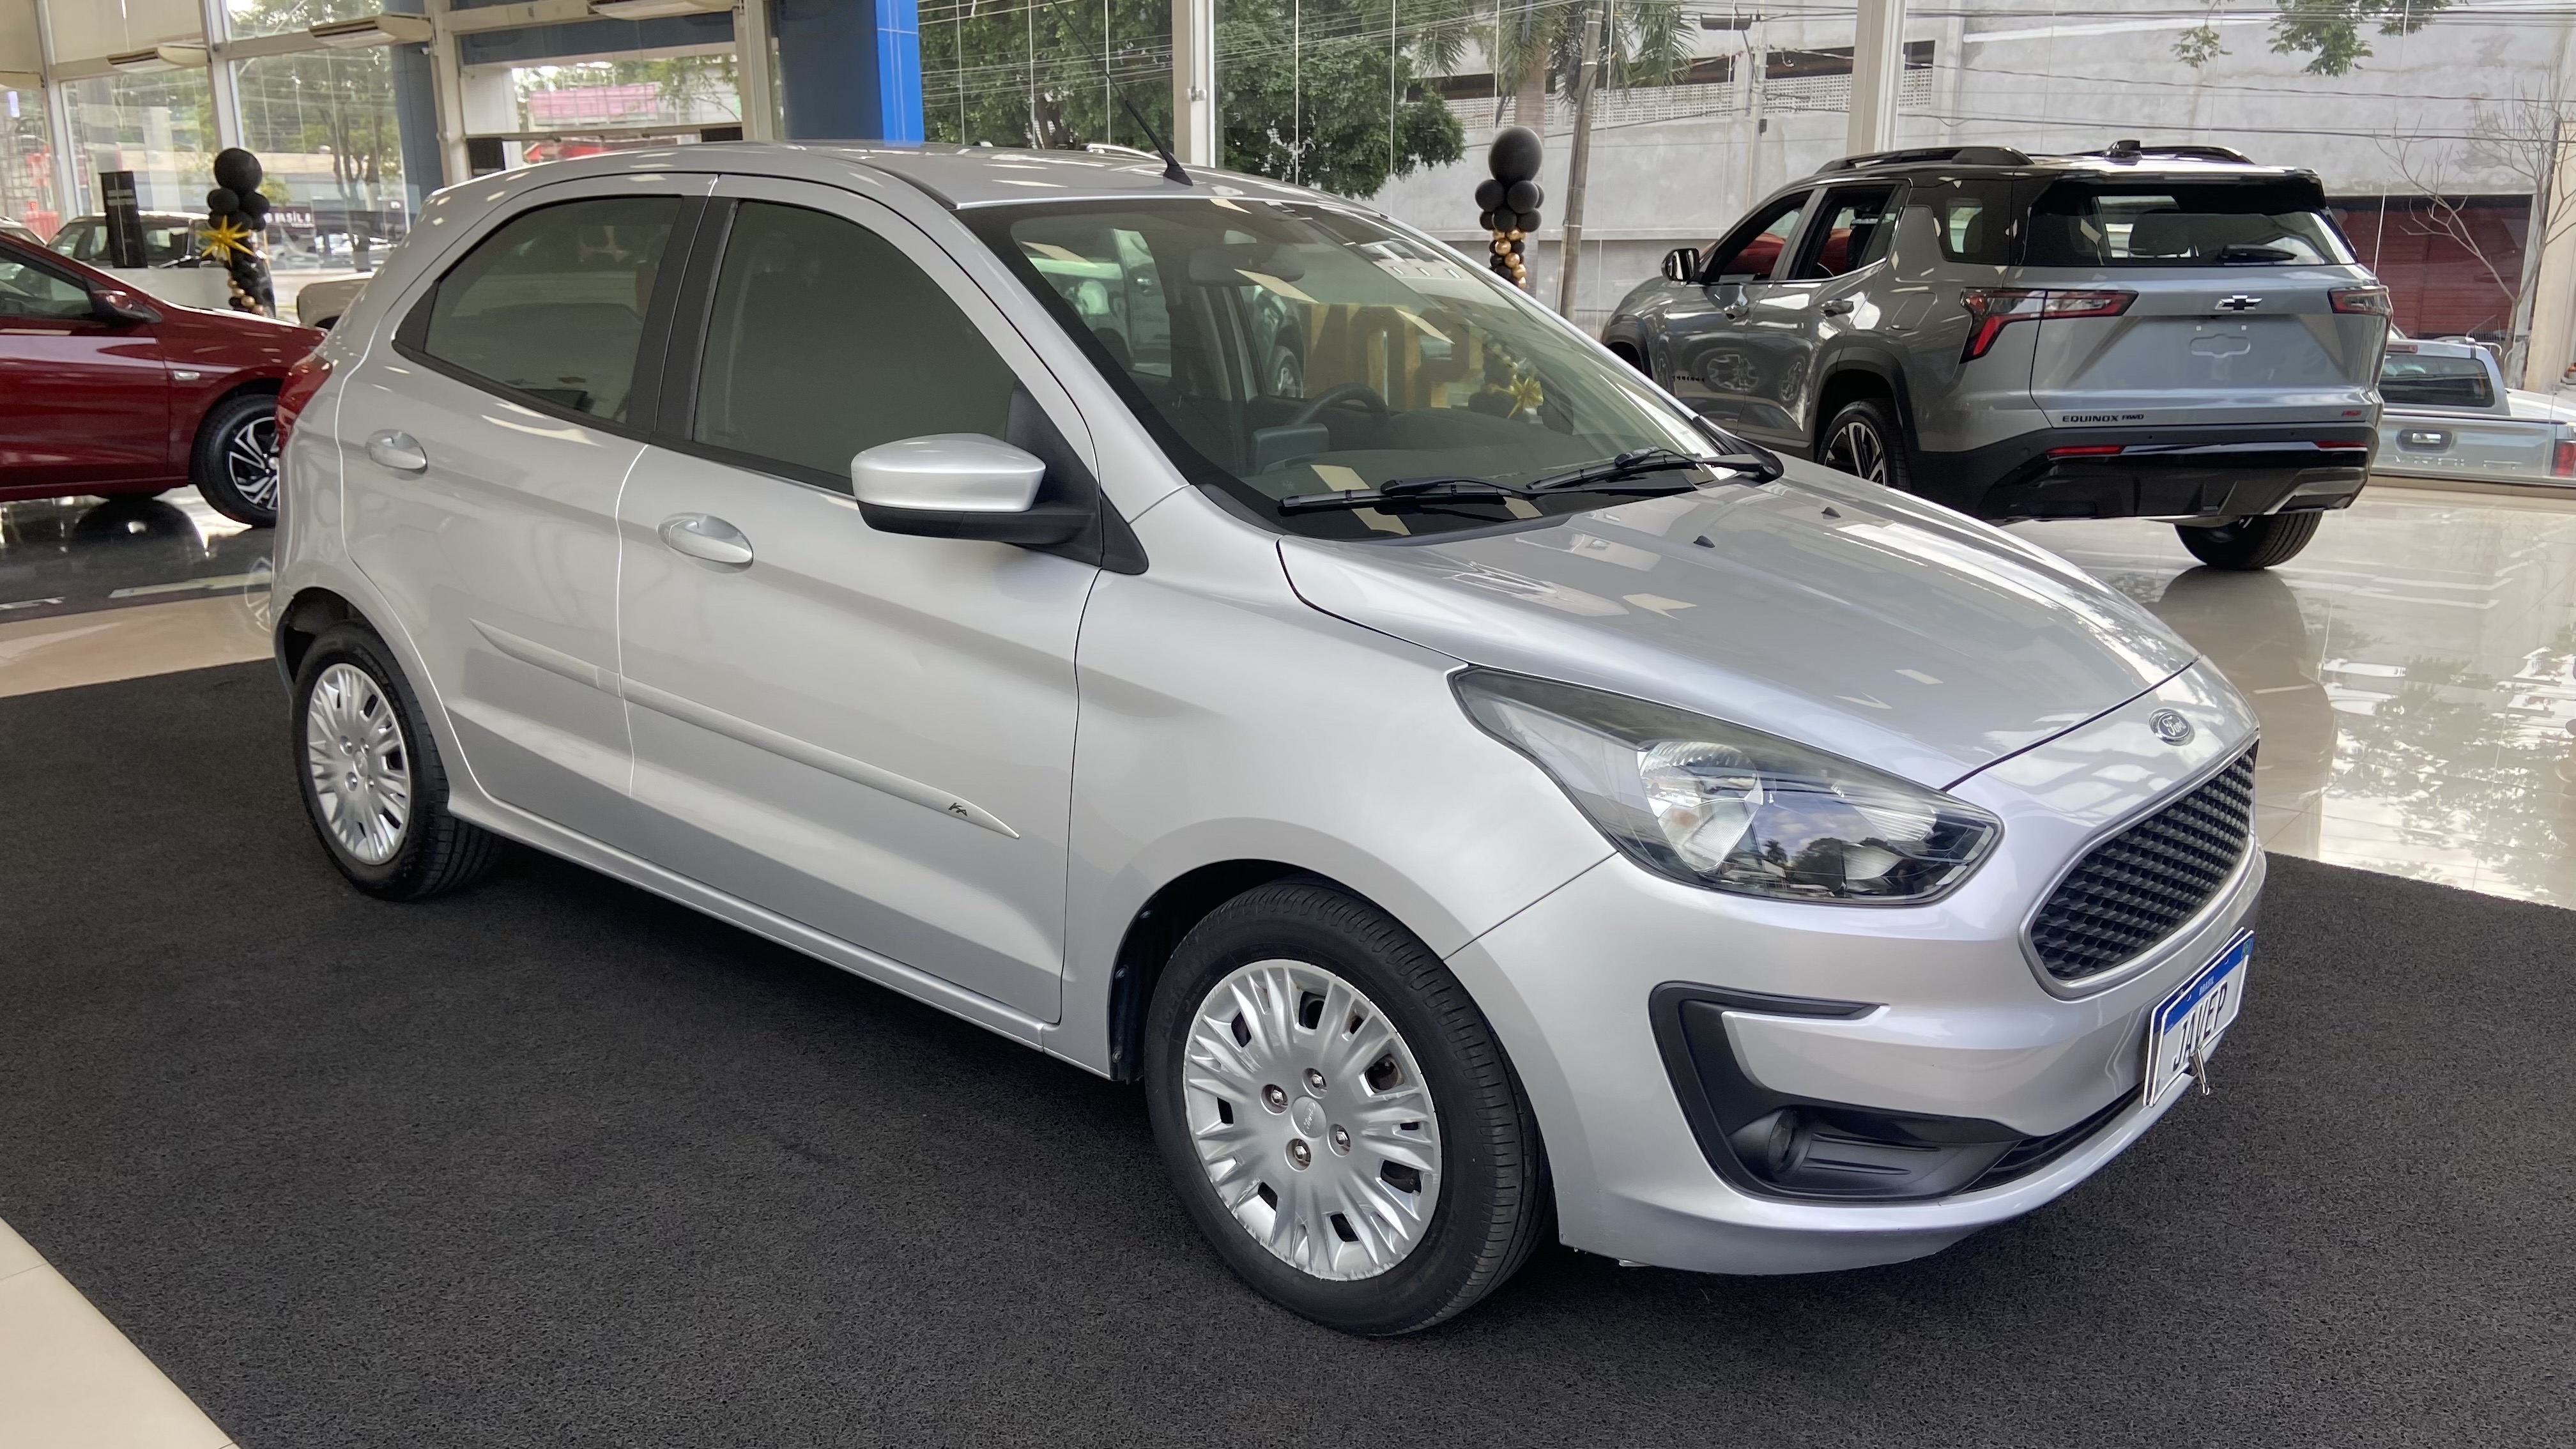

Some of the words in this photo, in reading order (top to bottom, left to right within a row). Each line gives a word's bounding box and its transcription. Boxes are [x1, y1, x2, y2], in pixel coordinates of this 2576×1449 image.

[2062, 415, 2119, 423] EQUINOX
[2161, 715, 2187, 736] Ford
[2198, 975, 2215, 997] BRASIL
[2172, 979, 2228, 1073] JAVEP
